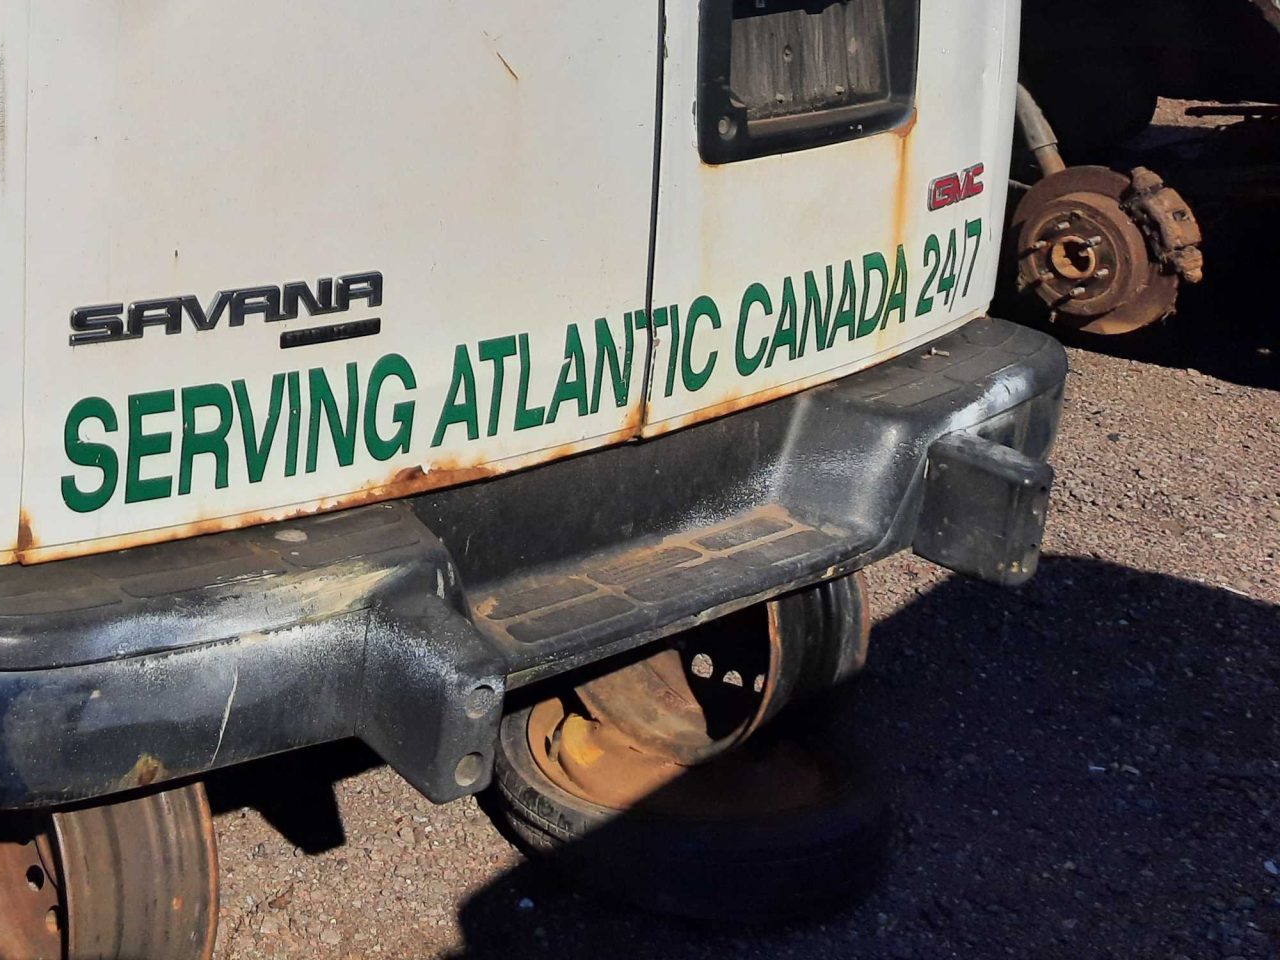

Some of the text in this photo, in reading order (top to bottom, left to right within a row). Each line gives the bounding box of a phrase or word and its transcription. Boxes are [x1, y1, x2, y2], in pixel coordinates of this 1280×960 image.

[927, 161, 985, 212] GMC
[67, 269, 384, 347] SAVANA
[60, 218, 983, 513] SERVING ATLANTIC CANADA 24/7
